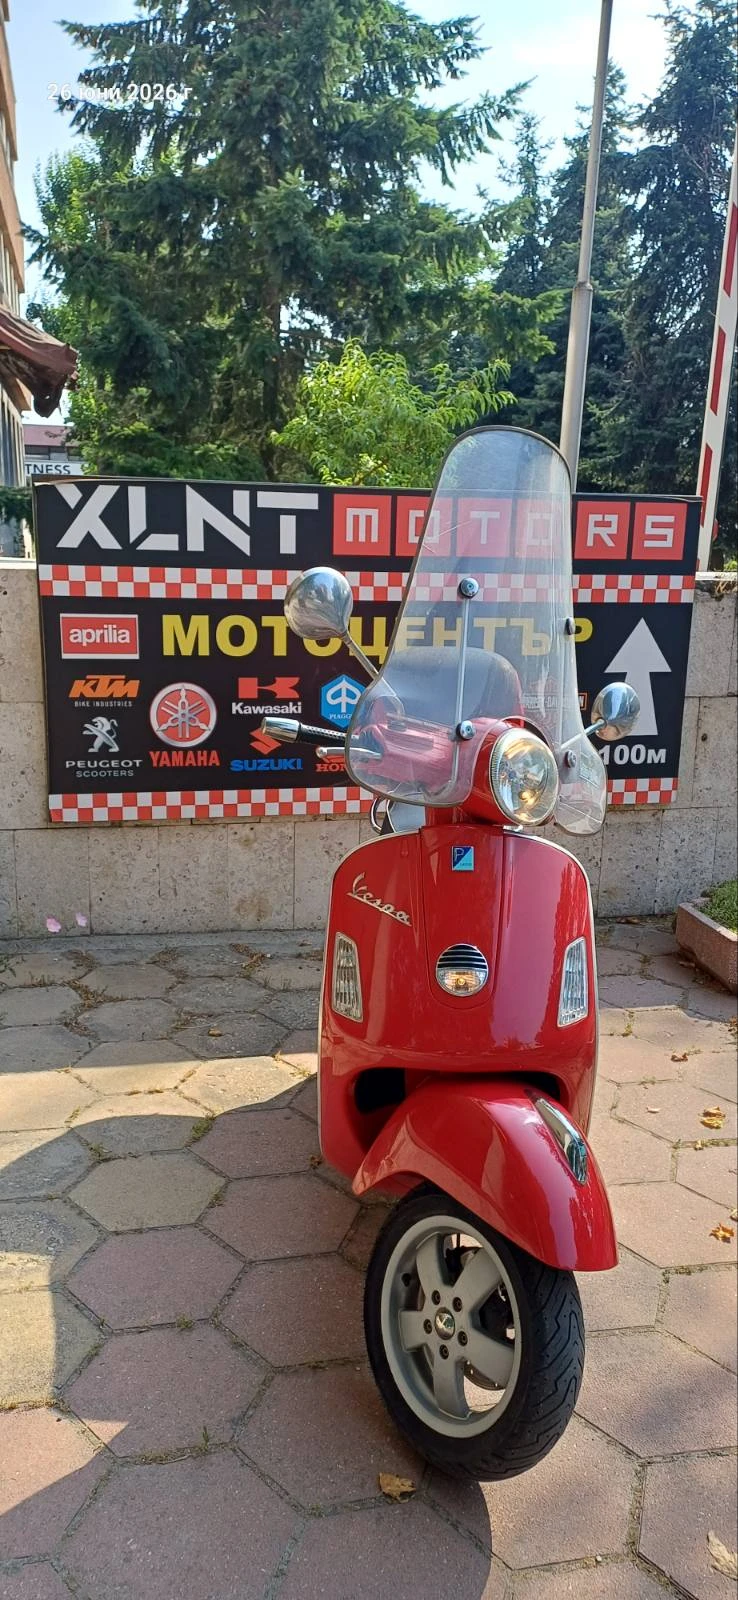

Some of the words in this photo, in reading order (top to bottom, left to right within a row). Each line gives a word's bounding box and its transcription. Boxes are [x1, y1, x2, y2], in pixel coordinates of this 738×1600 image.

[55, 484, 319, 556] XLNT
[345, 507, 675, 548] MOTORS
[69, 624, 131, 646] aprilia
[69, 675, 140, 698] KTM
[74, 700, 90, 708] BIKE
[93, 700, 133, 708] INDUSTRIES
[231, 702, 302, 715] Kawasaki
[65, 759, 143, 769] PEUGEOT
[149, 750, 220, 767] YAMAHA
[229, 758, 304, 772] SUZUKI
[75, 769, 134, 778] SCOOTERS
[347, 872, 412, 927] Vespa
